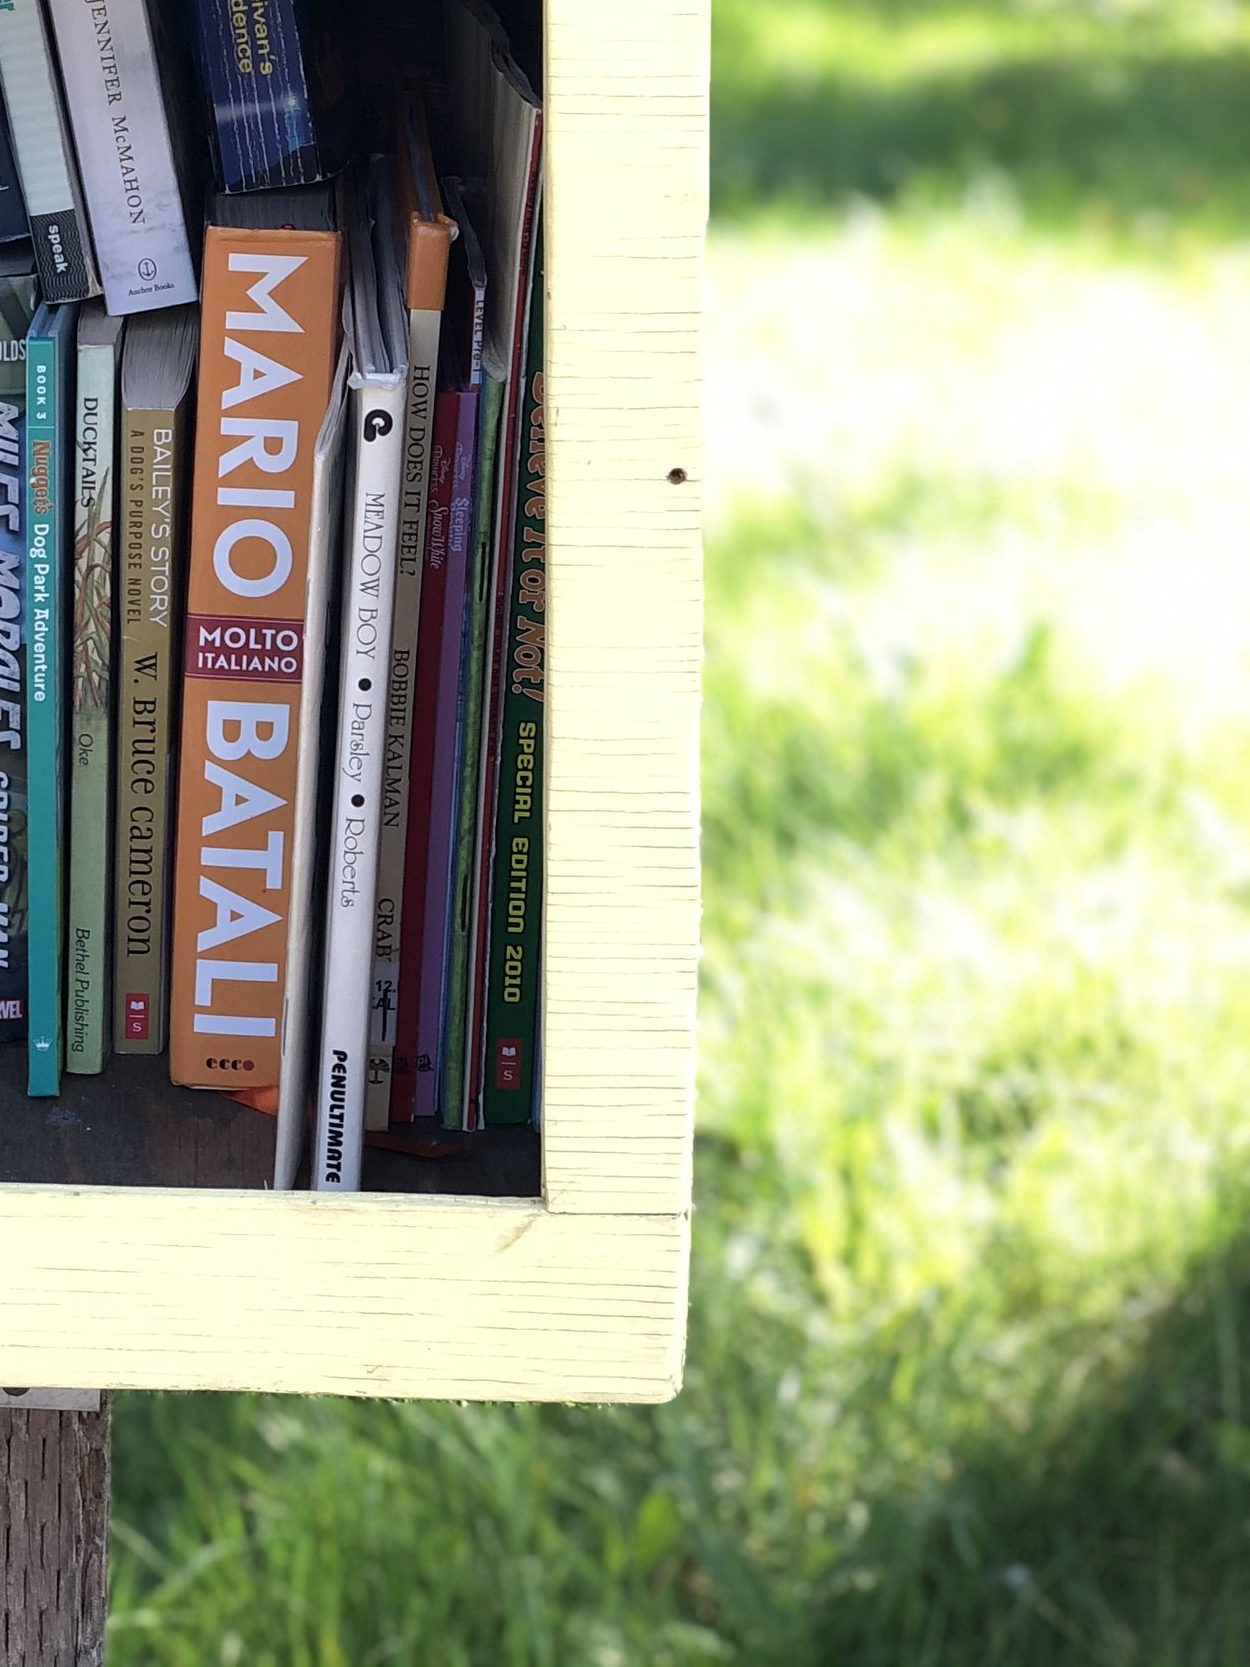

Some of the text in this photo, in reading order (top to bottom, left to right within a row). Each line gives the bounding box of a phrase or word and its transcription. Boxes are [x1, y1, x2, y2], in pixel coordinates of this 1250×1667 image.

[111, 115, 146, 225] McMAHON
[48, 224, 69, 275] speak
[154, 282, 175, 293] Books
[36, 365, 47, 420] BOOK 3
[213, 253, 309, 598] MARIO
[78, 397, 99, 508] DUCKTAILS
[28, 439, 51, 702] Nugget's Dog Park Adventure
[126, 444, 145, 625] DOG'S PURPOSE NOVEL
[150, 428, 173, 629] BAILEY'S STORY
[451, 496, 470, 552] Sleeping
[198, 626, 299, 652] MOLTO
[381, 364, 431, 828] HOW DOES IT FEEL? BOBBIE KALMAN
[197, 652, 298, 674] ITALIANO
[340, 492, 386, 908] MEADOW BOY Parsley Roberts
[78, 734, 94, 766] Oke
[512, 722, 536, 824] SPECIAL
[193, 700, 290, 1037] BATALI
[508, 837, 530, 933] EDITION
[71, 927, 91, 1053] Bethel Publishing
[503, 945, 523, 1004] 2010
[206, 1057, 255, 1072] ecco
[326, 1049, 348, 1185] PENULTIMATE
